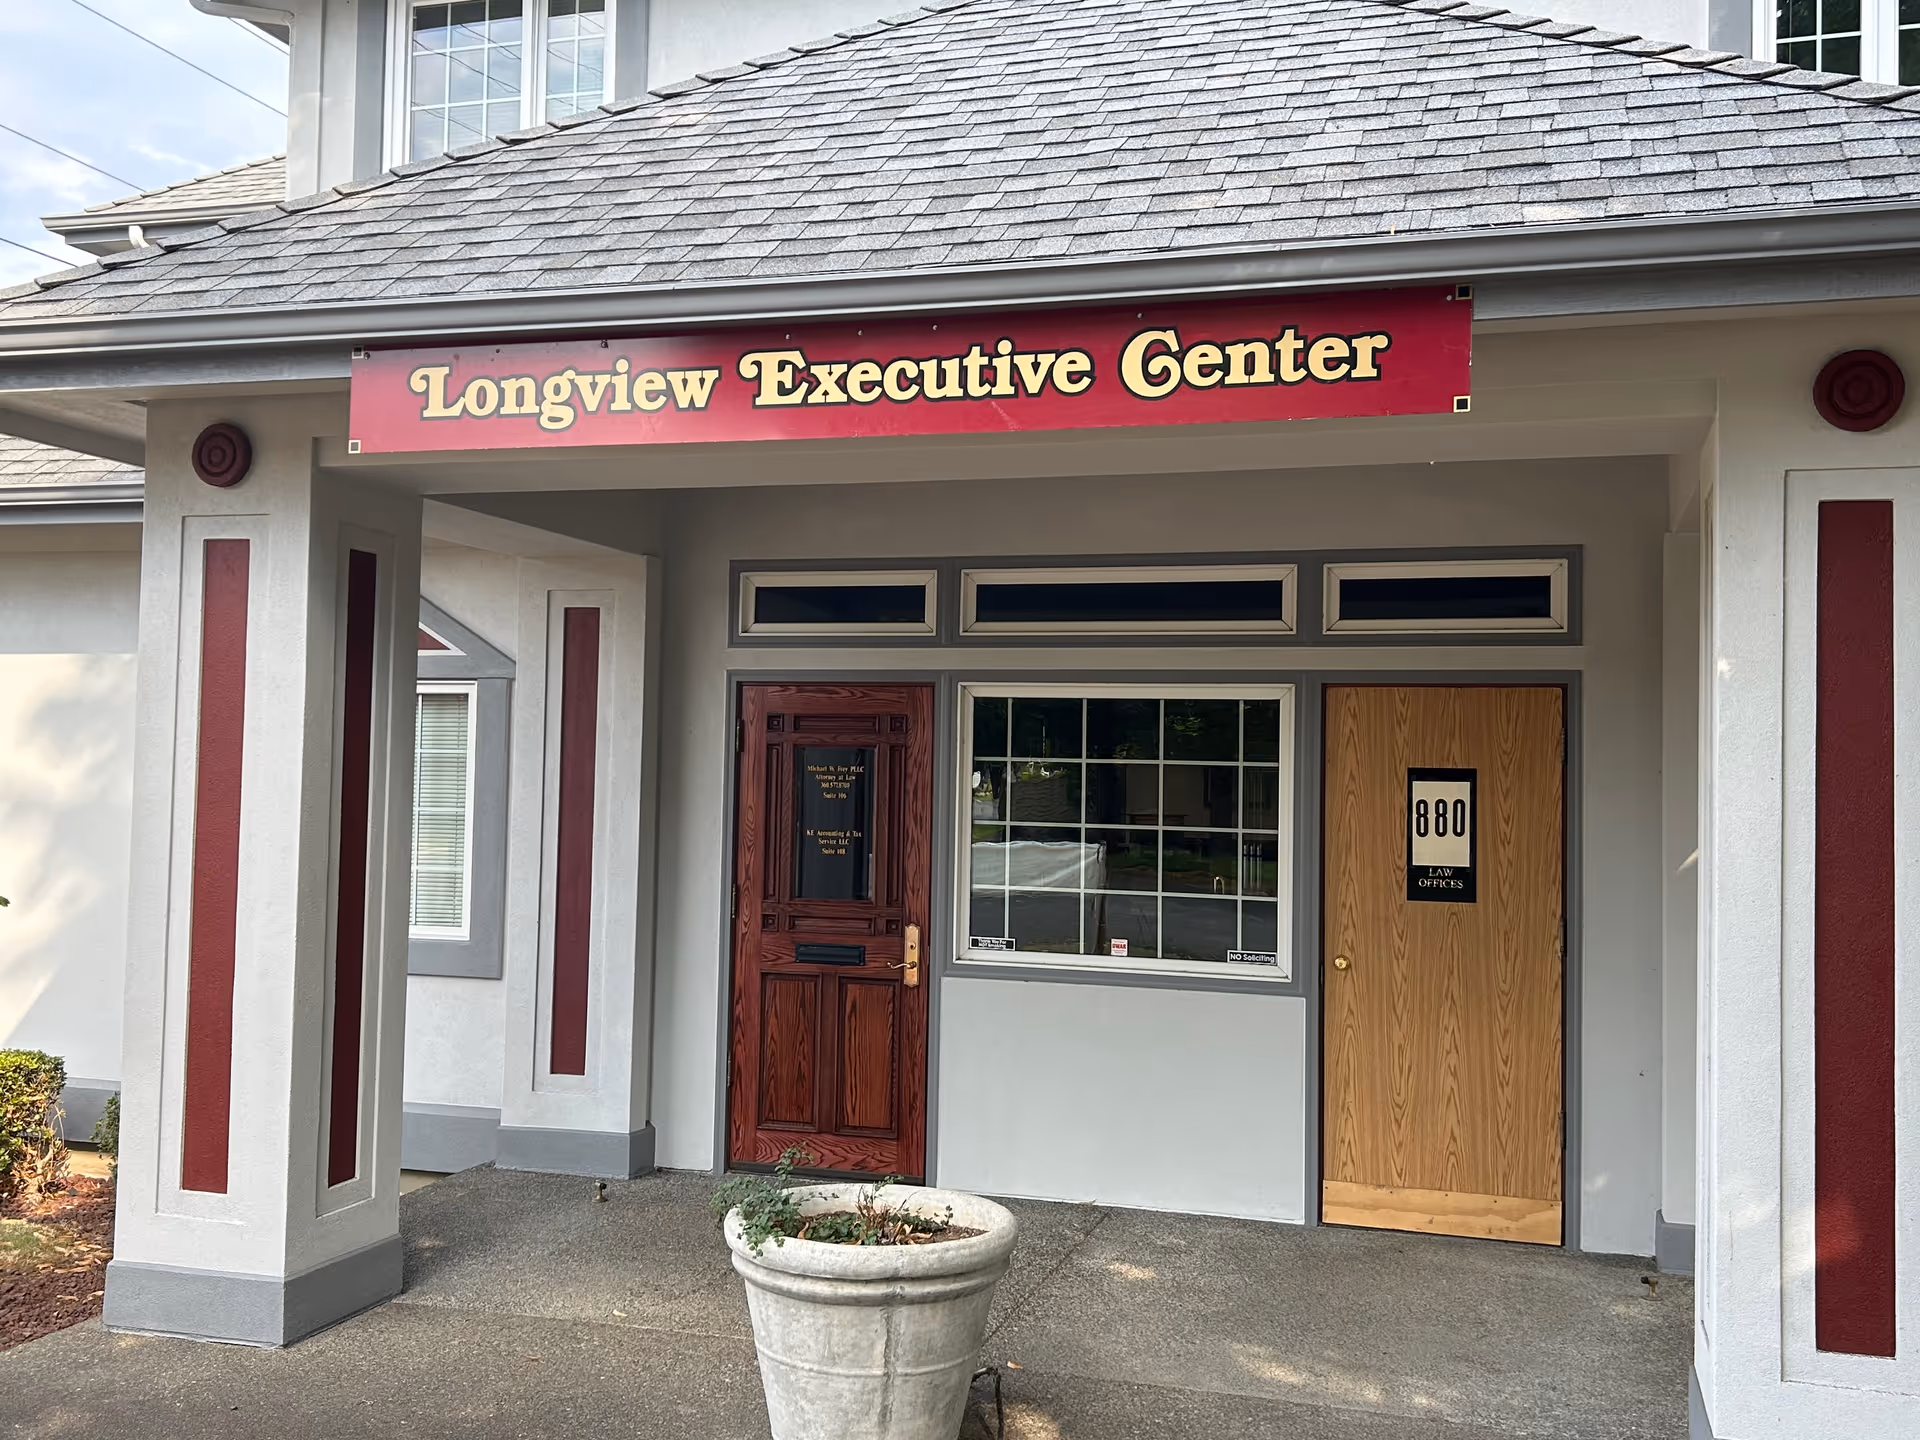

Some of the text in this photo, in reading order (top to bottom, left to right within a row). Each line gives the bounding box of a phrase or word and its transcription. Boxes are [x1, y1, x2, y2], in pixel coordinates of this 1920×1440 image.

[408, 327, 1391, 429] Longview Executive Center
[850, 765, 865, 773] PLLC
[822, 791, 837, 799] Suite
[1416, 798, 1465, 838] 880
[821, 847, 836, 855] Suite
[1428, 867, 1454, 877] LAW
[1418, 878, 1464, 889] OFFICES
[1230, 953, 1275, 963] NO Soliciting
